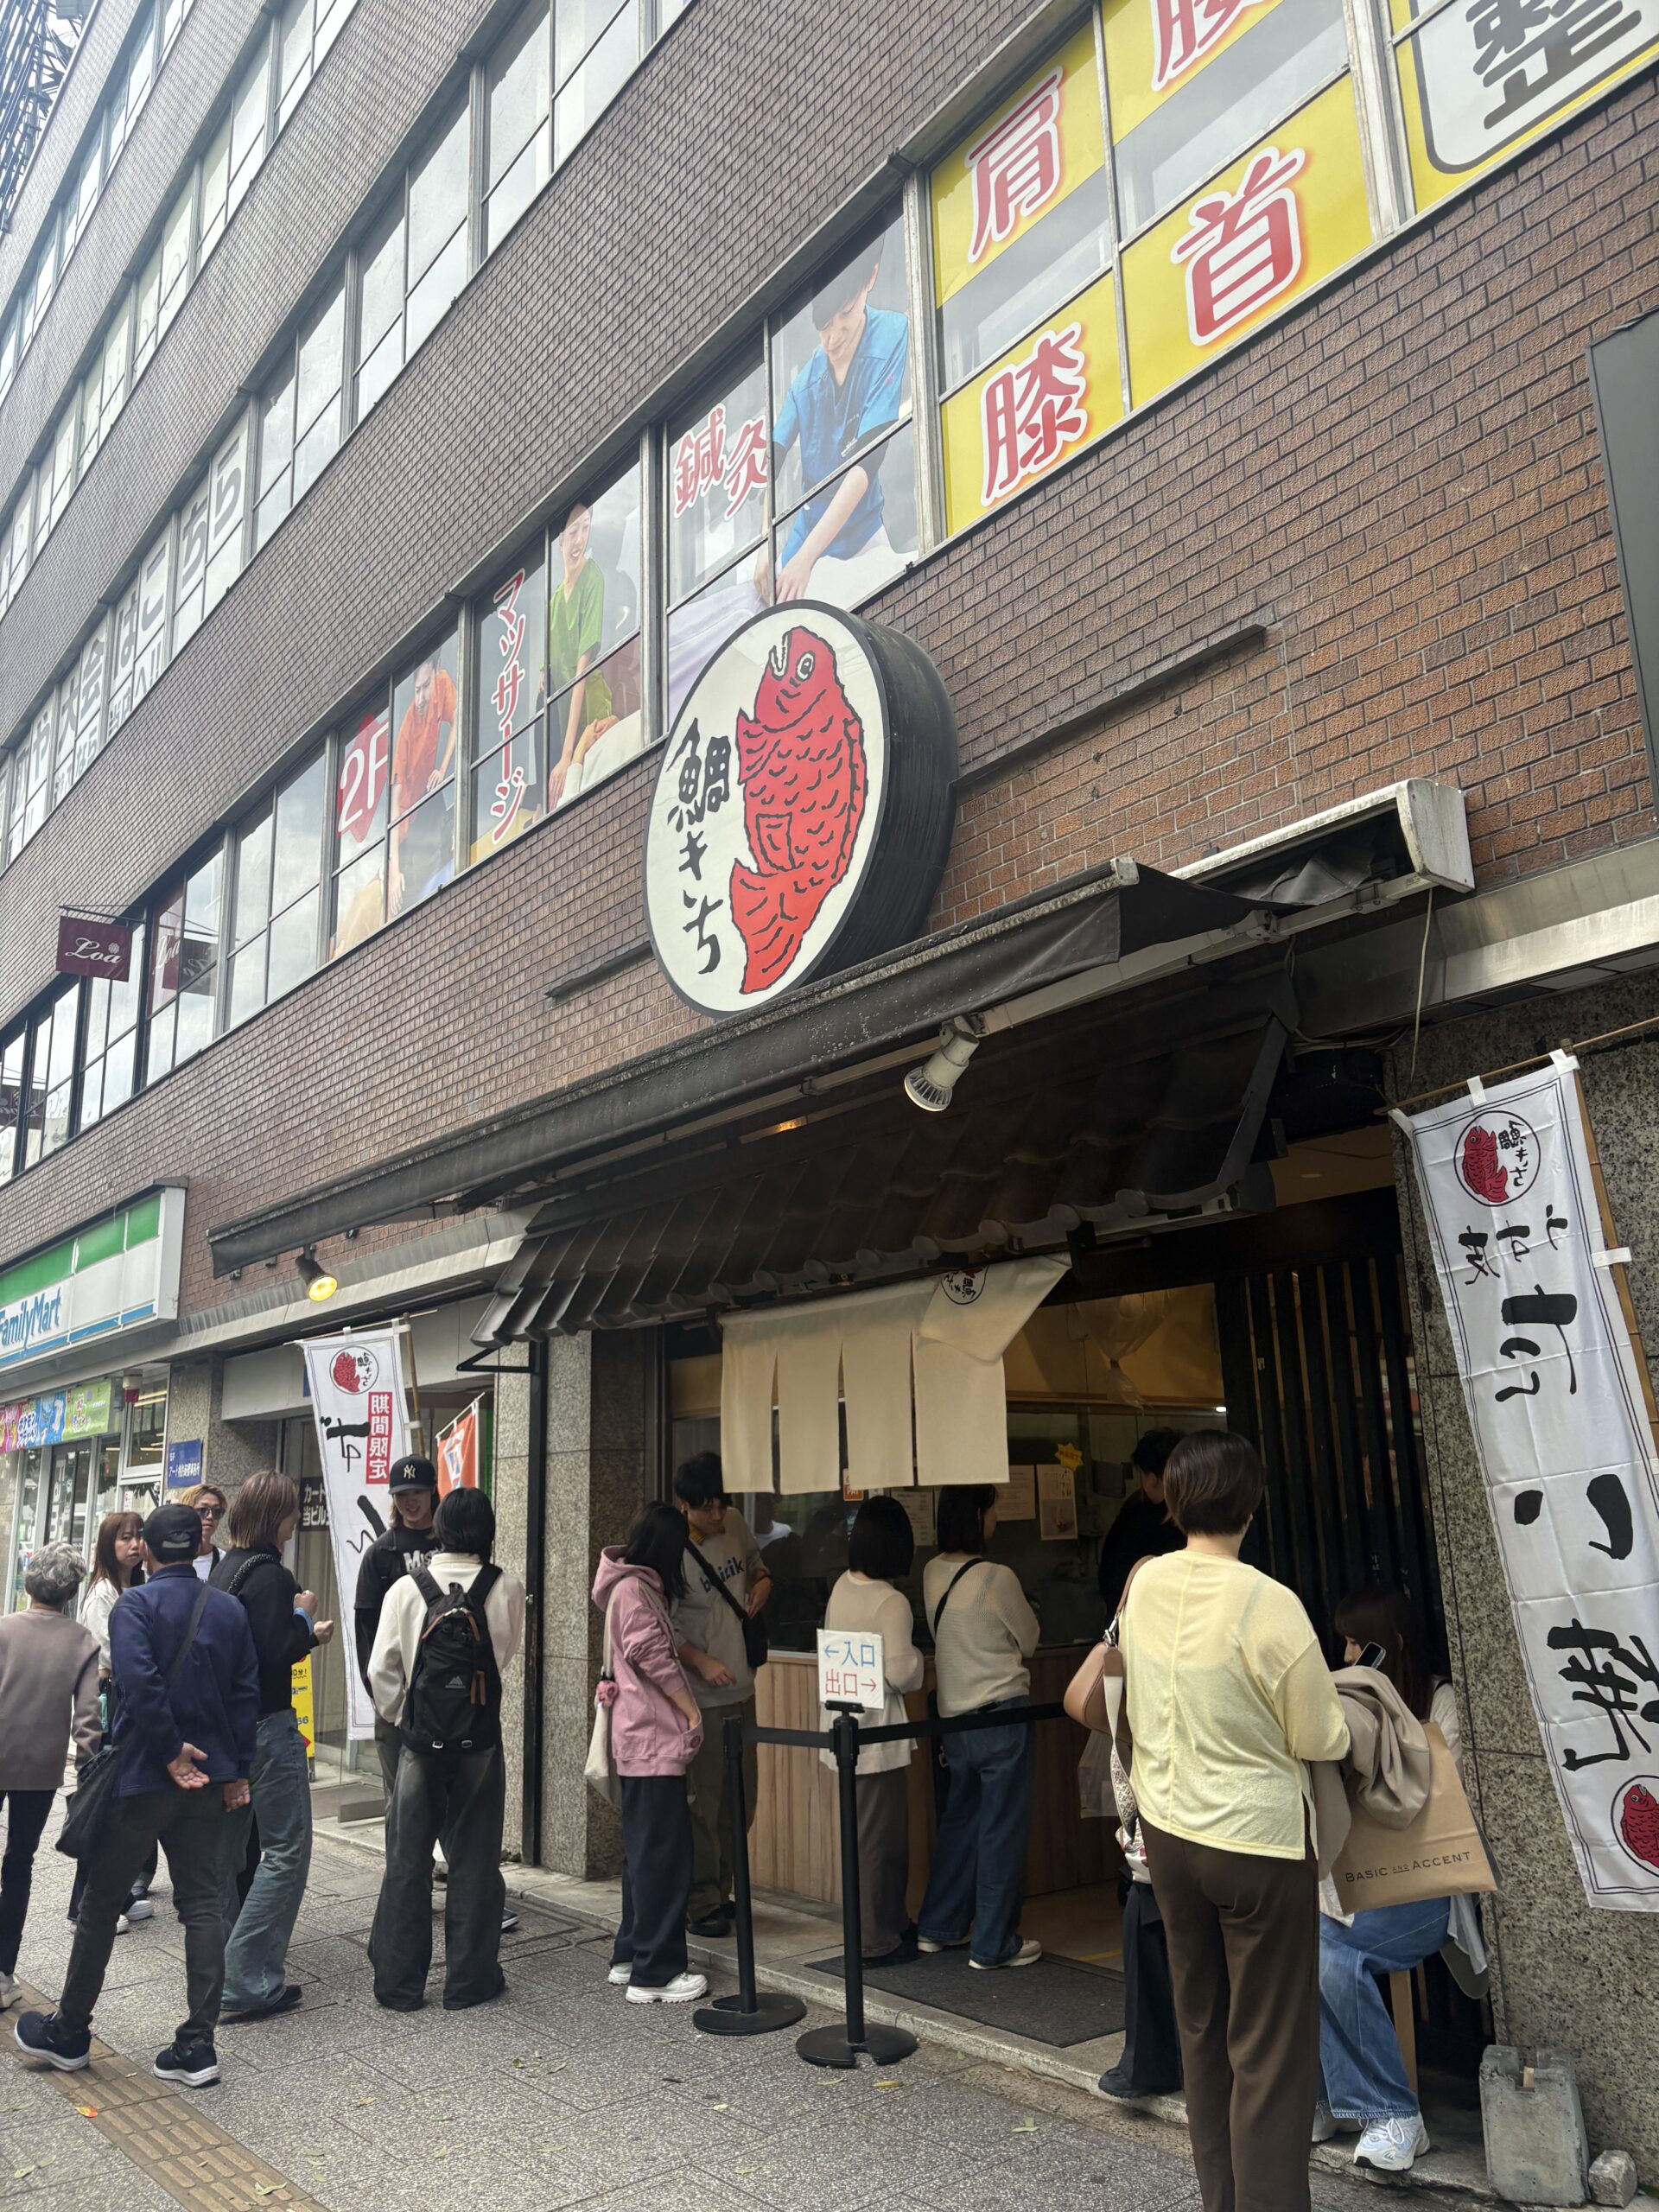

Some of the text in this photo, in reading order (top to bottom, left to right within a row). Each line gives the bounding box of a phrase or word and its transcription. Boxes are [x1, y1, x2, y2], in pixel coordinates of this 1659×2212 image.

[968, 66, 1063, 263] 肩
[1171, 148, 1305, 345] 首
[673, 404, 768, 519] 鍼灸
[981, 322, 1086, 506] 膝
[492, 569, 525, 844] マッサージ
[338, 722, 389, 834] 2F
[666, 718, 731, 974] 鯛きち
[65, 938, 123, 964] Loa
[404, 1465, 416, 1478] NY
[825, 1669, 858, 1696] 出口
[842, 1641, 875, 1667] 入口
[1345, 1852, 1471, 1882] BASIC AND ACCENT
